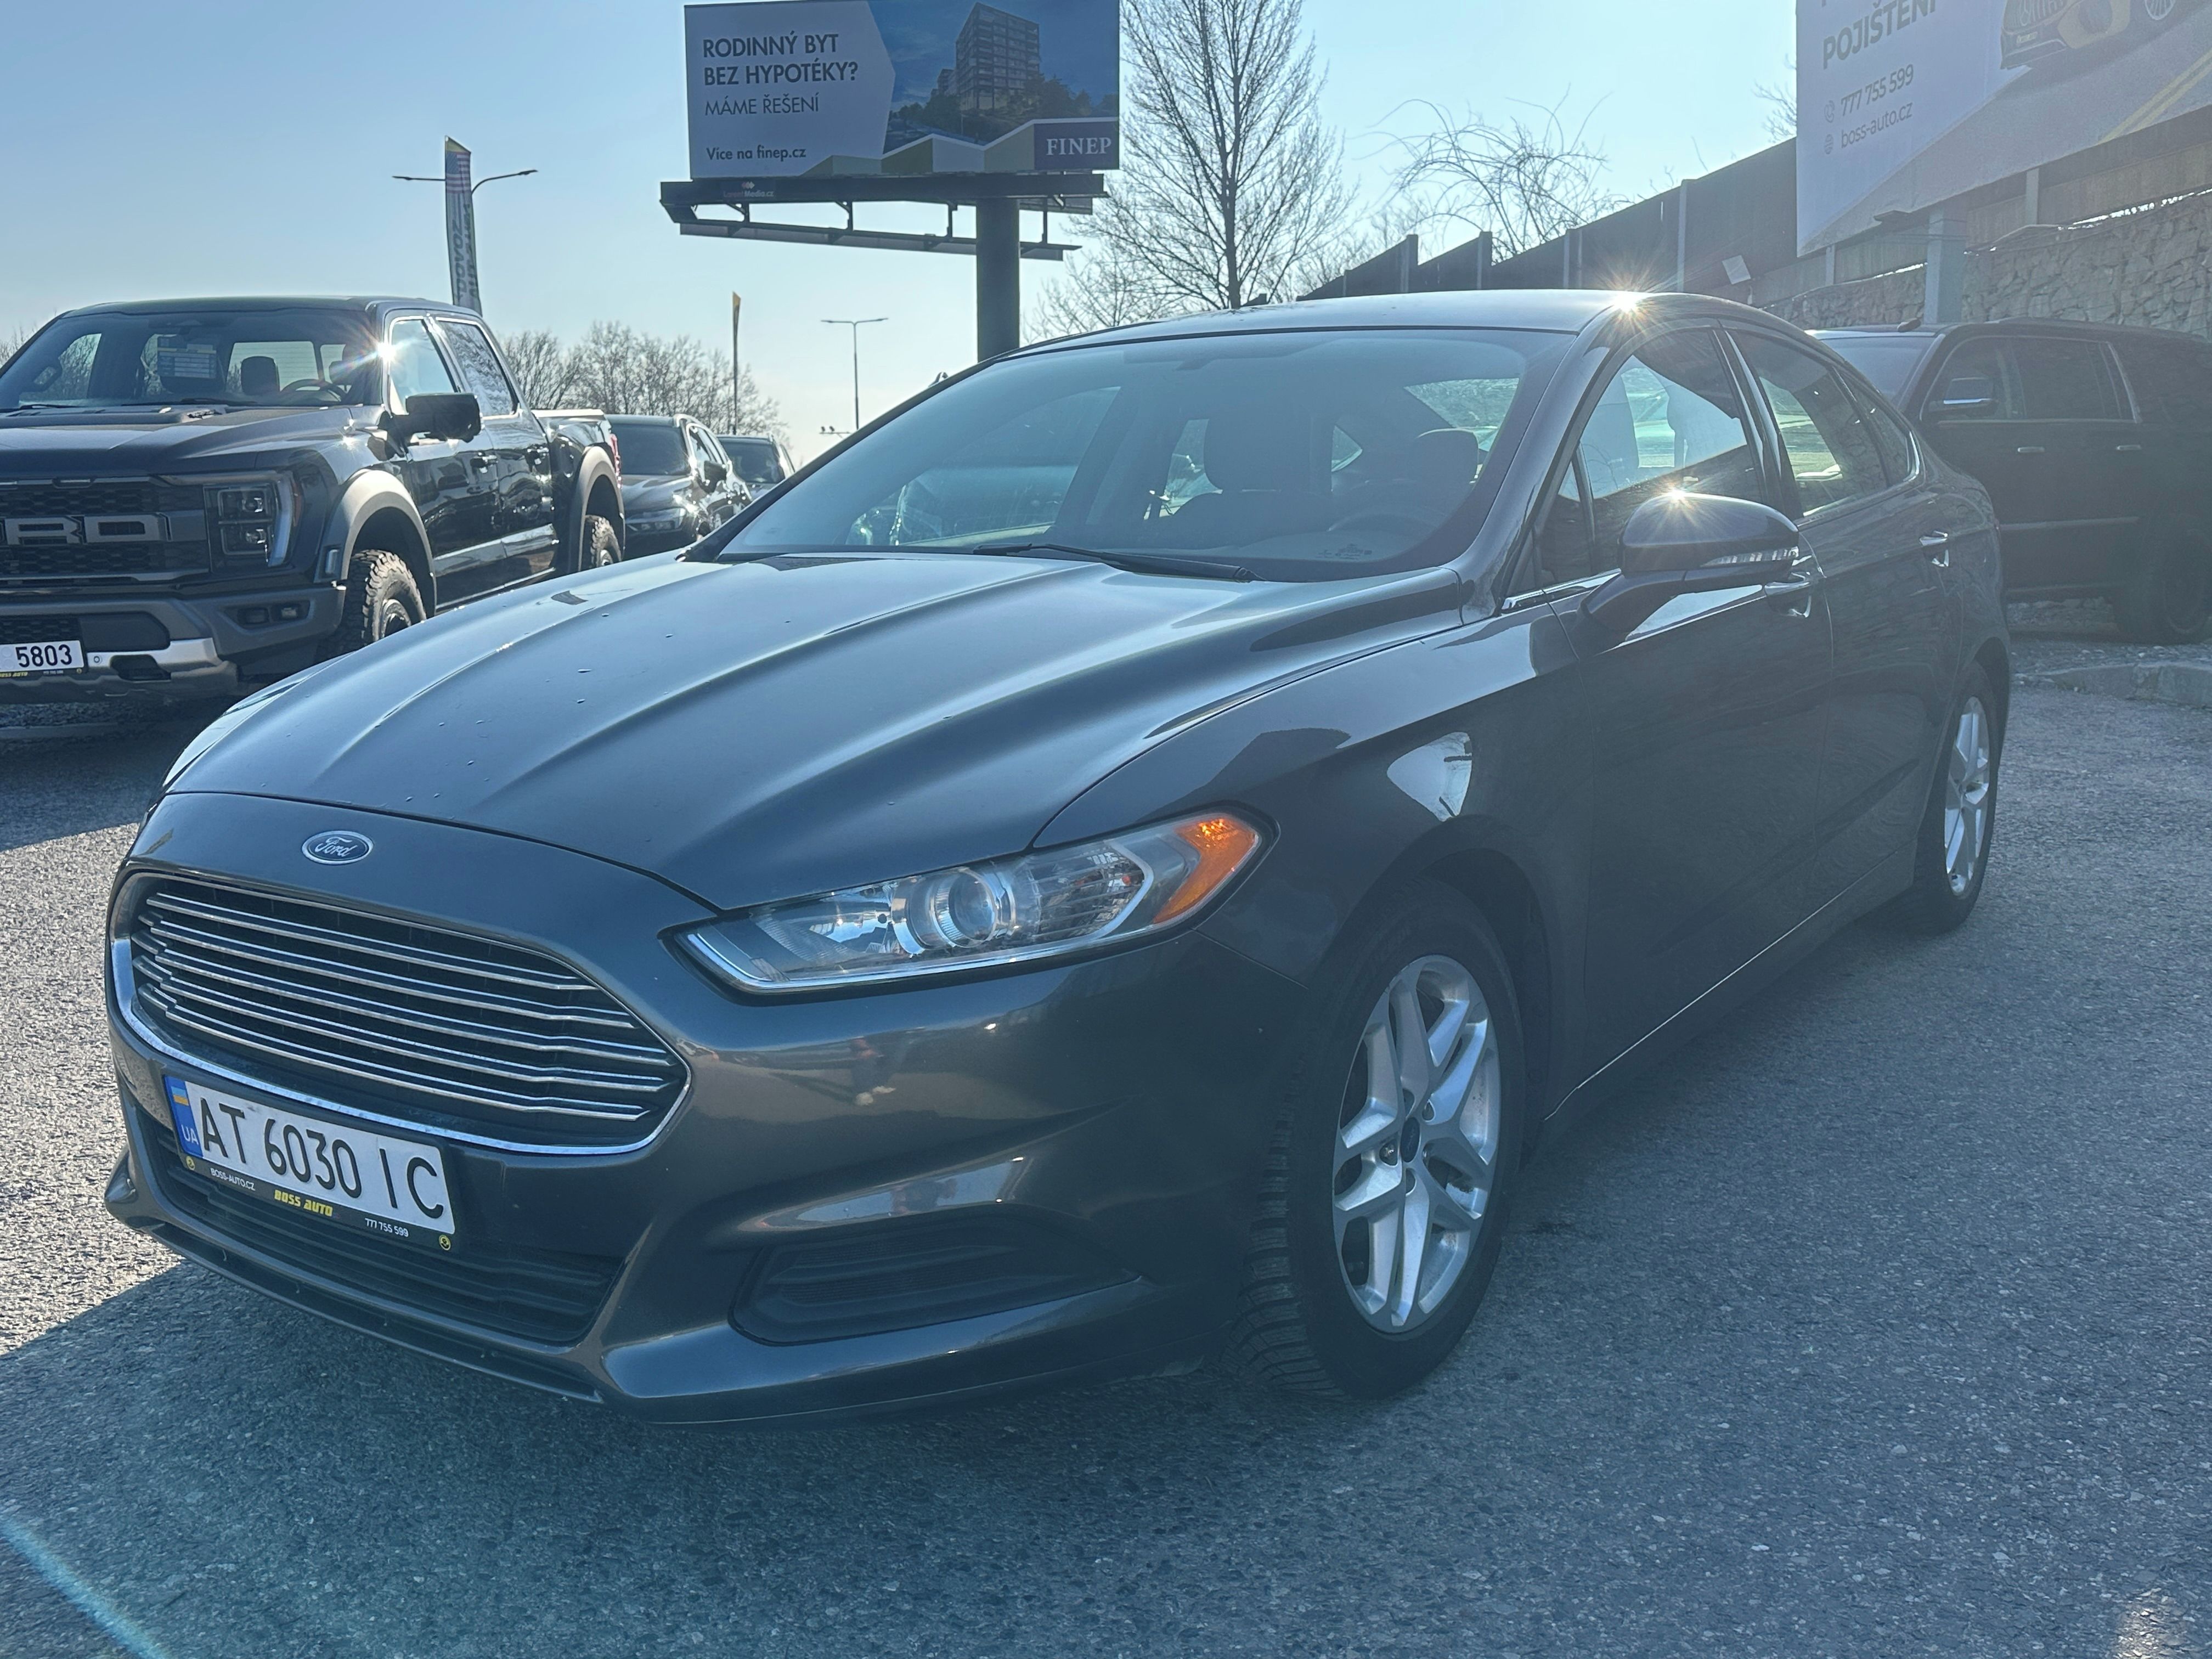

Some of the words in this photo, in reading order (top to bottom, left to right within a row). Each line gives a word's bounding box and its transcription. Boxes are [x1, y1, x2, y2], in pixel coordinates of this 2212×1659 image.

[703, 30, 798, 58] RODINNÝ
[804, 33, 839, 54] BYT
[704, 66, 739, 86] BEZ
[746, 58, 859, 84] HYPOTÉKY?
[1841, 88, 1863, 117] 777
[1865, 76, 1886, 105] 755
[1889, 64, 1914, 93] 599
[705, 95, 757, 115] MÁME
[763, 92, 819, 114] ŘEŠENÍ
[1841, 102, 1913, 148] boss-auto.cz
[706, 147, 733, 160] Více
[737, 150, 752, 159] na
[757, 144, 806, 162] finep.cz
[1046, 137, 1111, 155] FINEP
[15, 644, 72, 668] 5803
[314, 836, 358, 857] Ford
[181, 1125, 199, 1145] UA
[201, 1097, 246, 1164] AT
[264, 1118, 362, 1198] 6030
[379, 1148, 444, 1218] IC
[210, 1167, 256, 1191] BOSS-AUTO.CZ
[274, 1189, 301, 1207] BOSS
[303, 1199, 333, 1217] AUTO
[365, 1218, 377, 1229] 777
[379, 1222, 393, 1233] 755
[394, 1226, 409, 1237] 599
